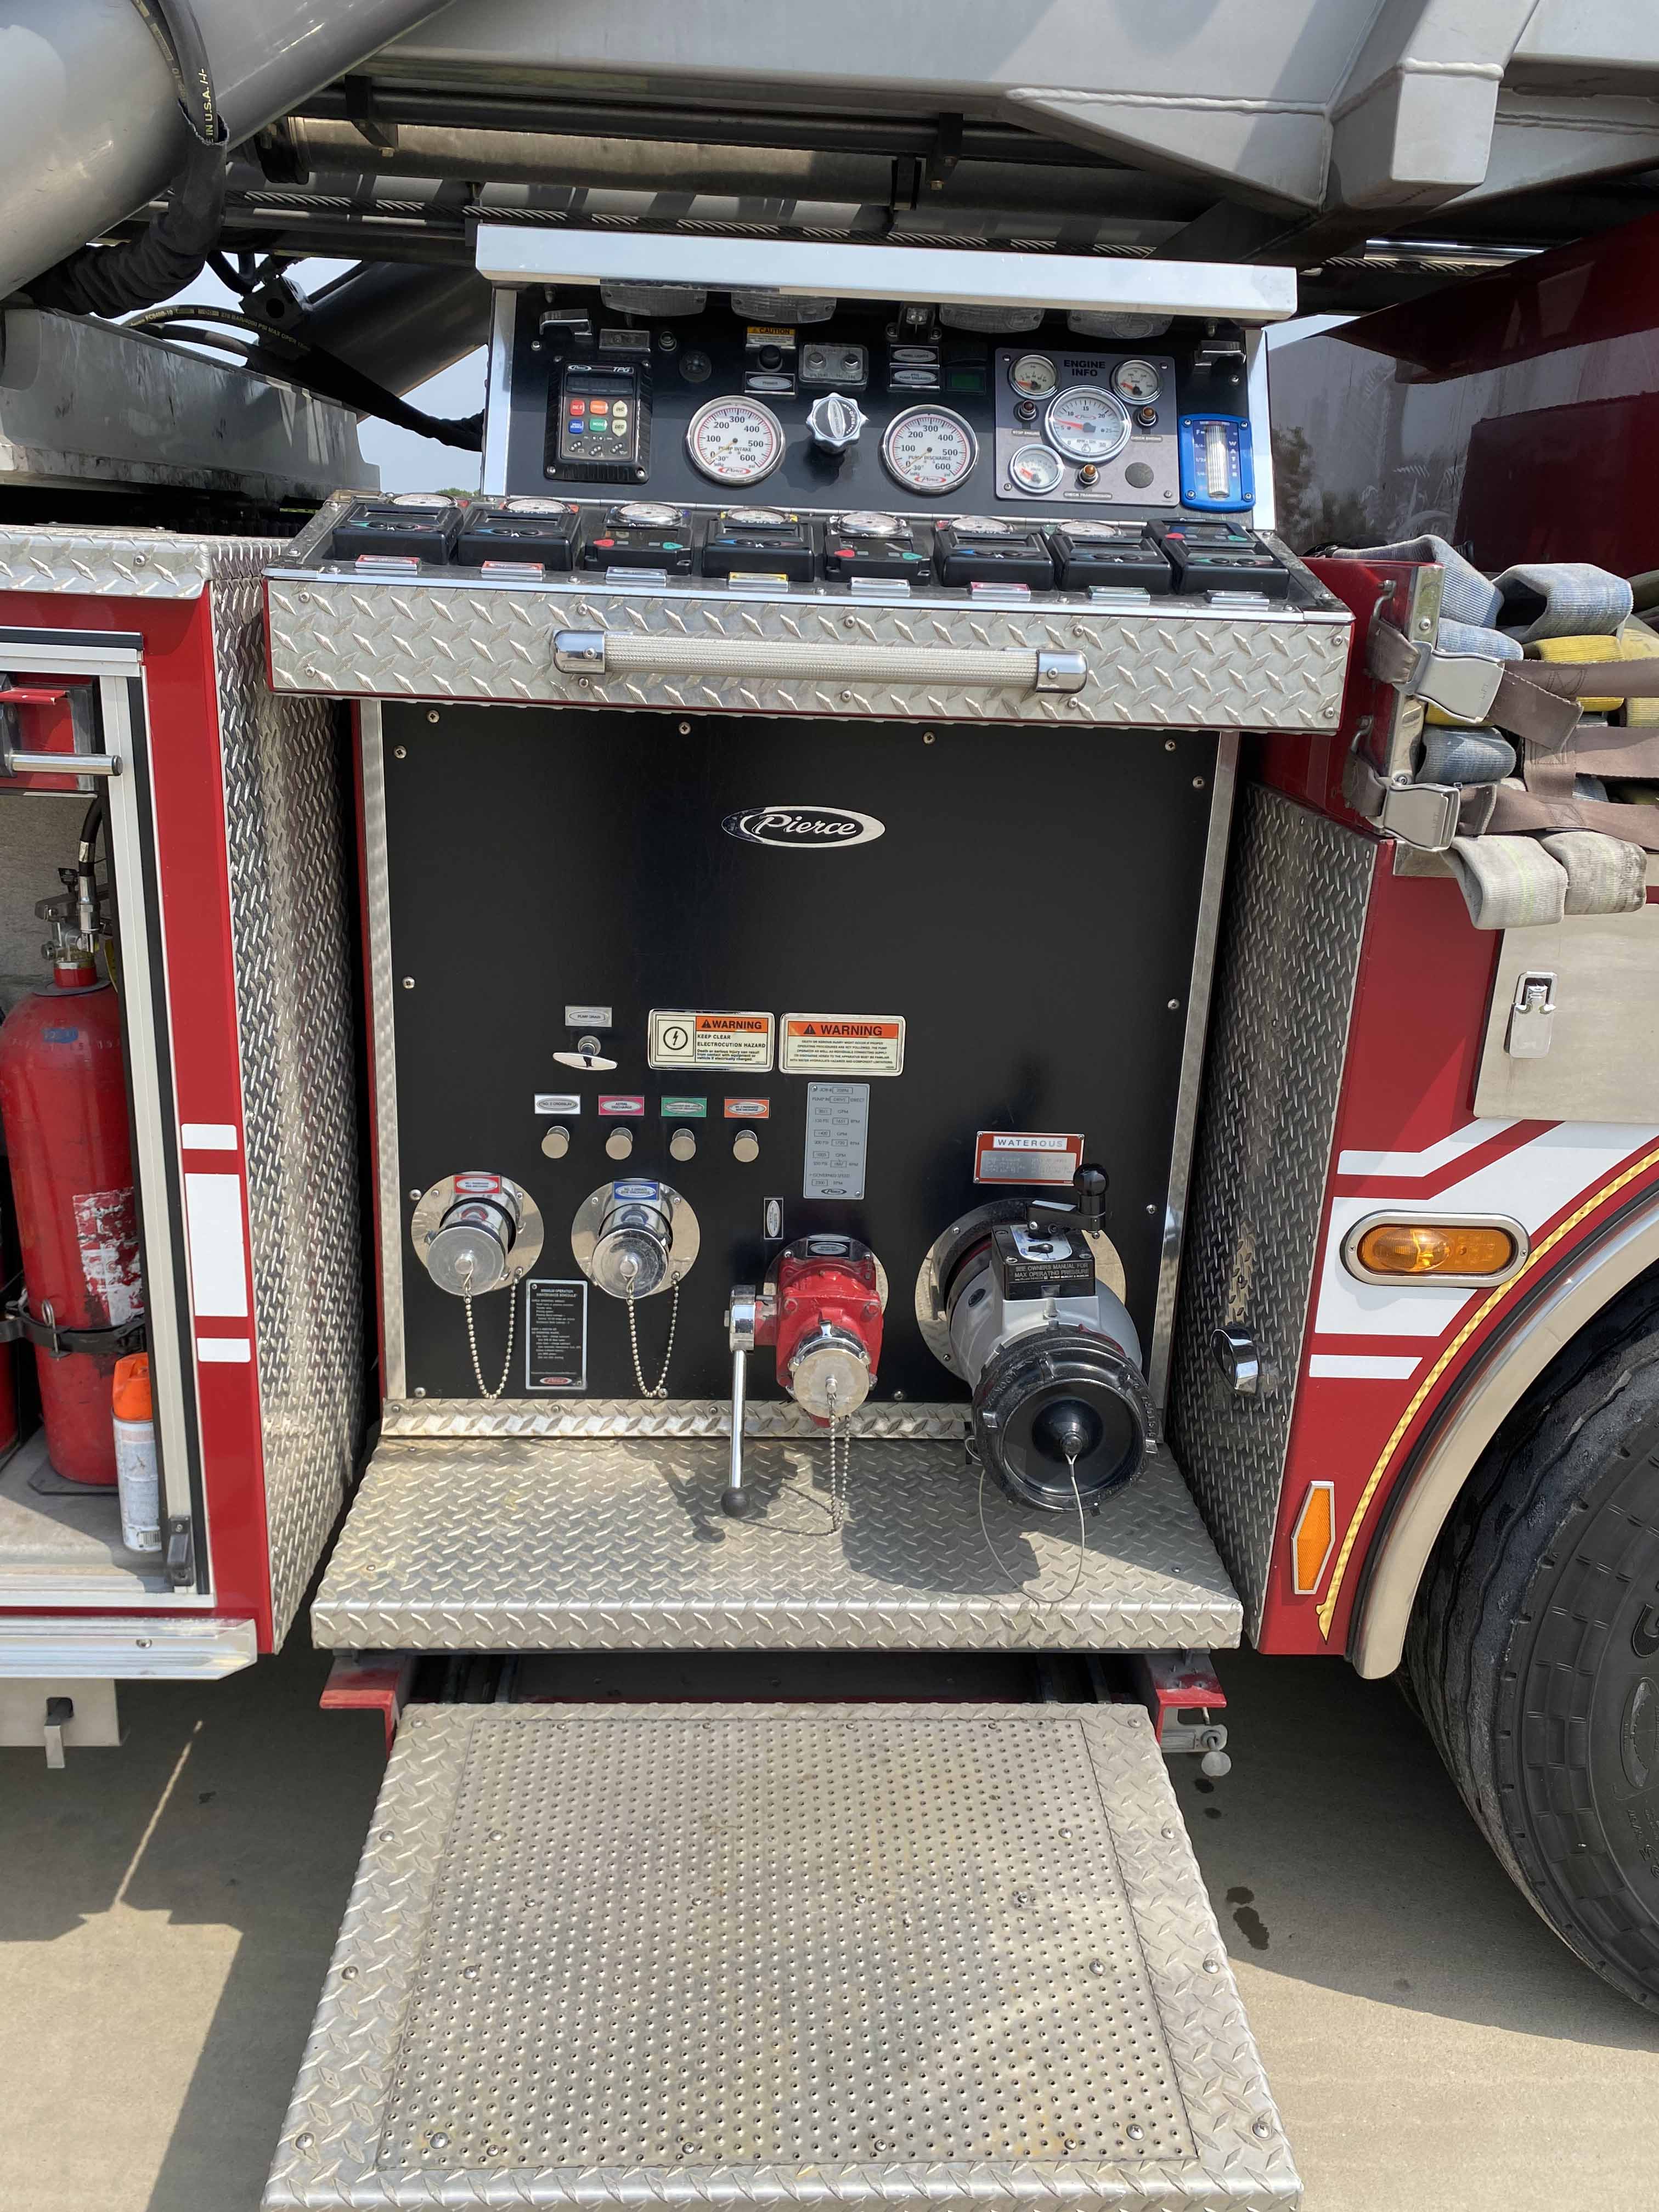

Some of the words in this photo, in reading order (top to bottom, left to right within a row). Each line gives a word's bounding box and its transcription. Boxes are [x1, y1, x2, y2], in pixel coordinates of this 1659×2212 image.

[202, 87, 213, 122] U.S.A.
[205, 125, 213, 136] IN
[1063, 360, 1106, 369] ENGINE
[1071, 369, 1098, 377] INFO
[751, 814, 857, 835] Pierce
[712, 1020, 763, 1029] WARNING
[820, 1025, 883, 1036] WARNING
[997, 1139, 1063, 1147] WATEROUS
